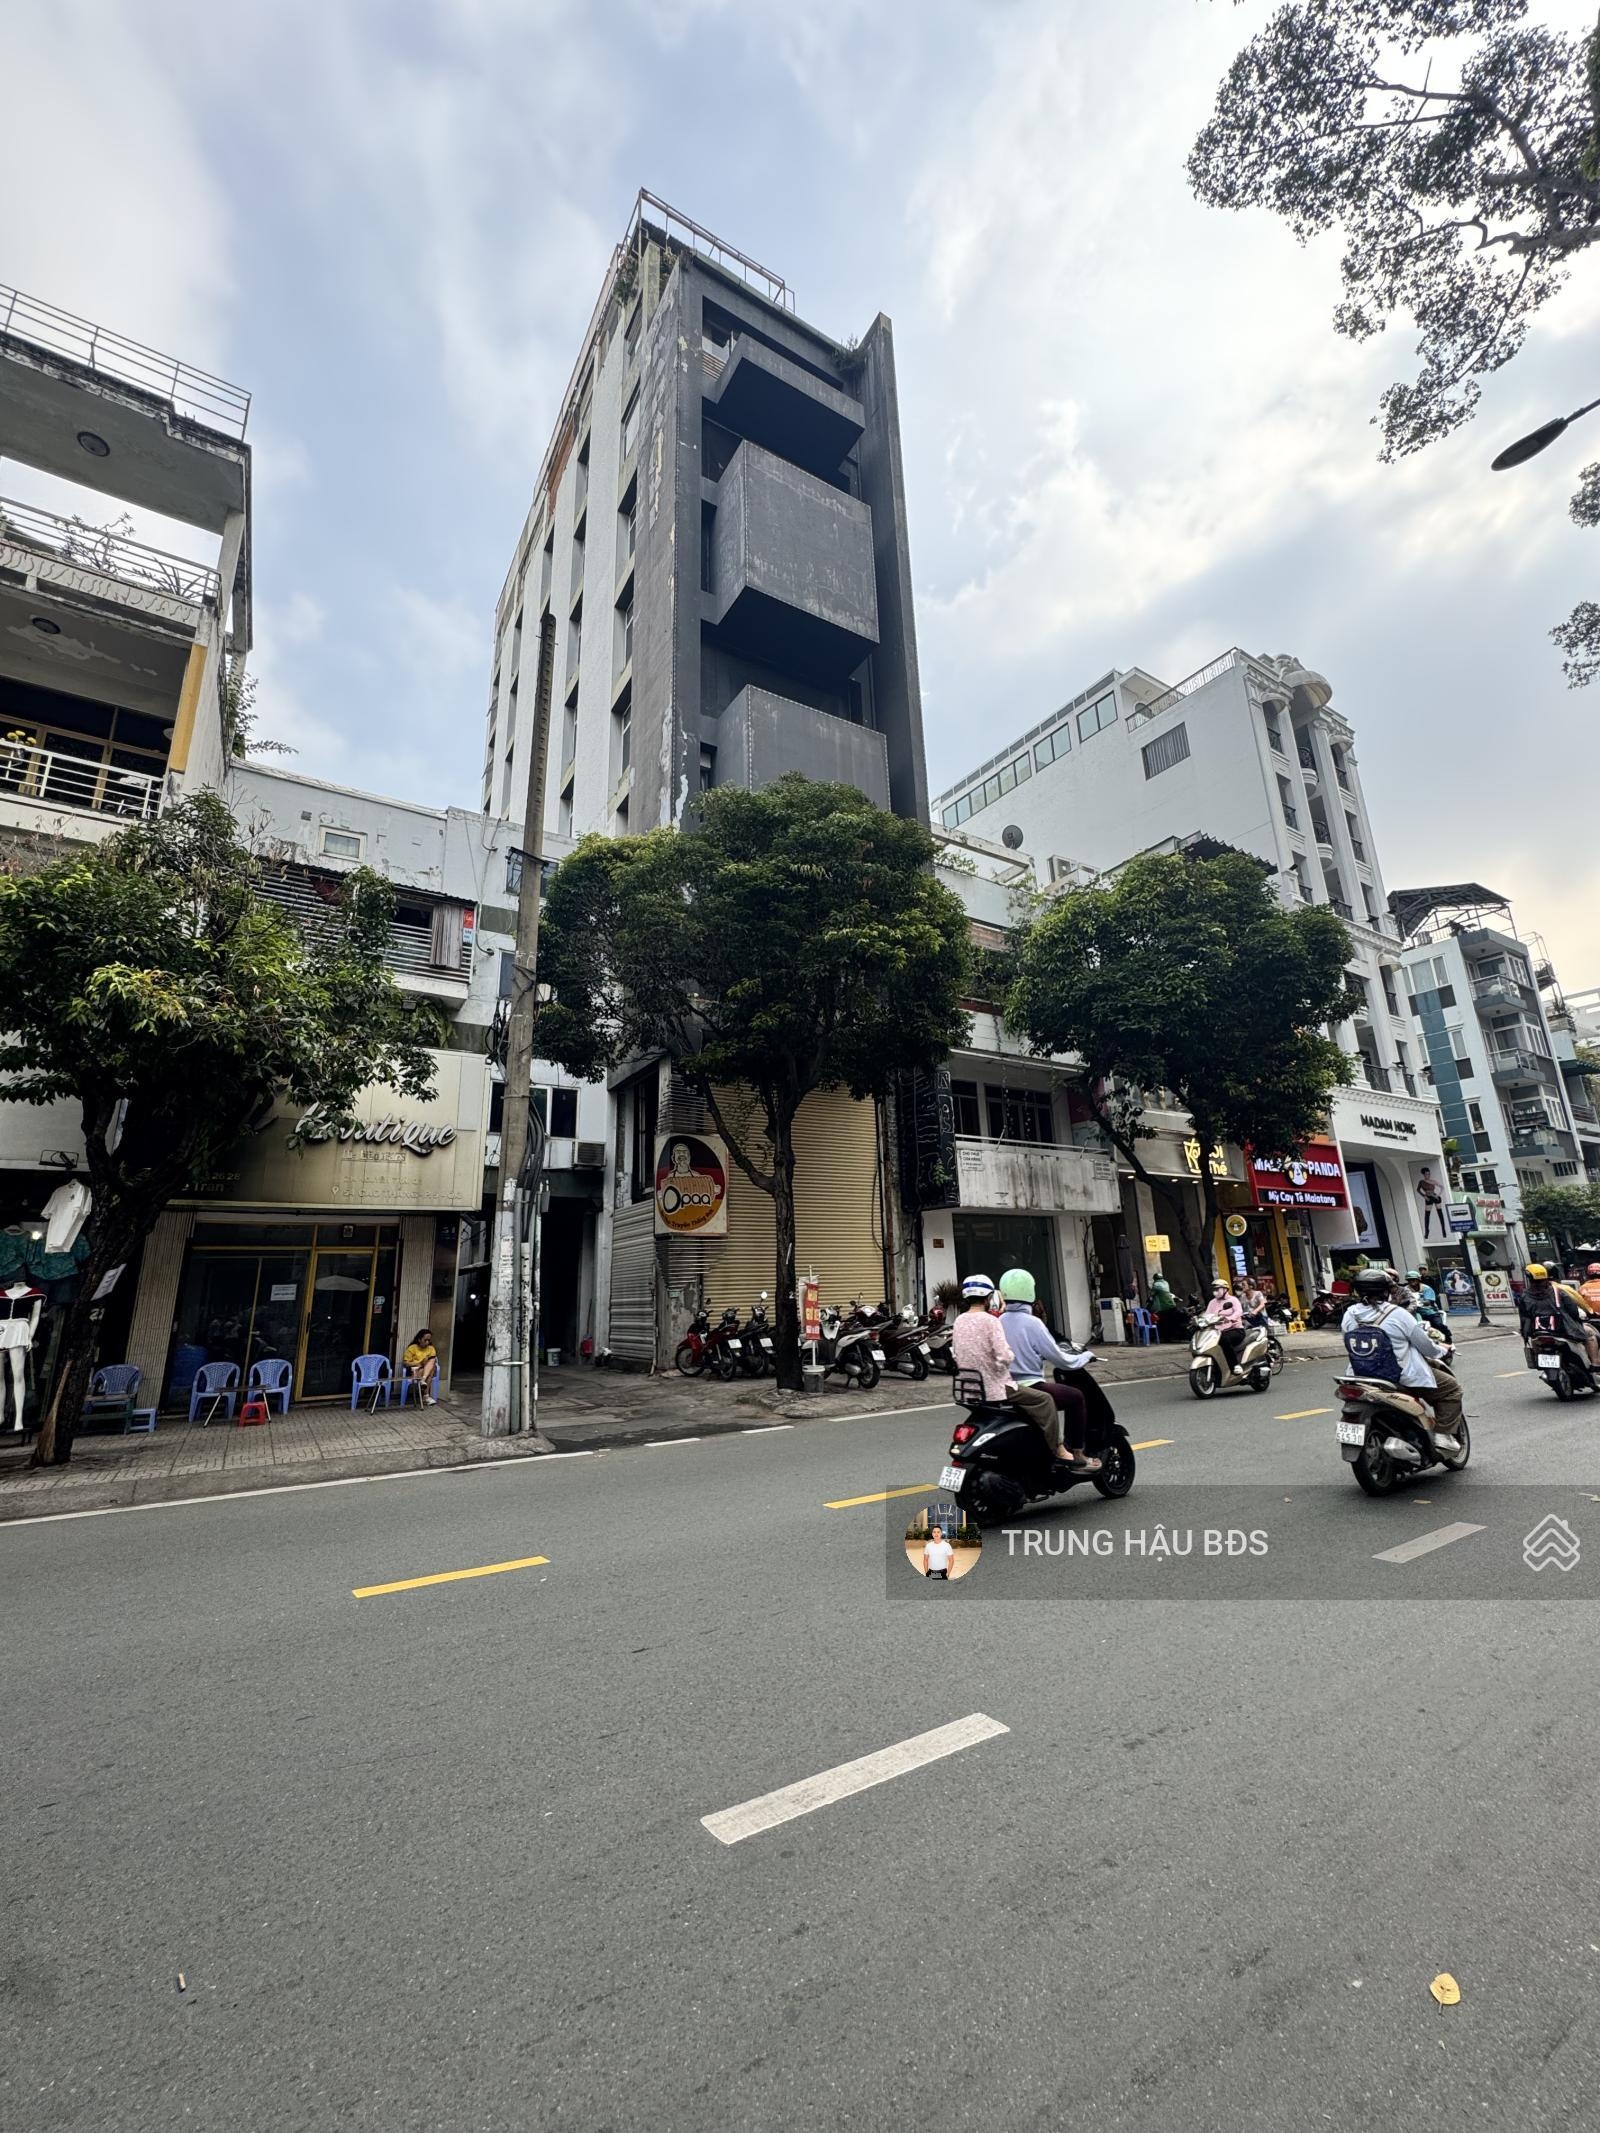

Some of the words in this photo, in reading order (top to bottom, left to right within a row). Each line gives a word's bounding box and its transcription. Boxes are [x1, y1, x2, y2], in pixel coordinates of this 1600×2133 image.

[1360, 1113, 1393, 1131] MADAM
[1394, 1120, 1417, 1135] HONG
[1307, 1160, 1342, 1177] PANDA
[663, 1185, 711, 1213] Opaa
[1280, 1191, 1294, 1205] Cay
[1305, 1192, 1336, 1206] Malatang
